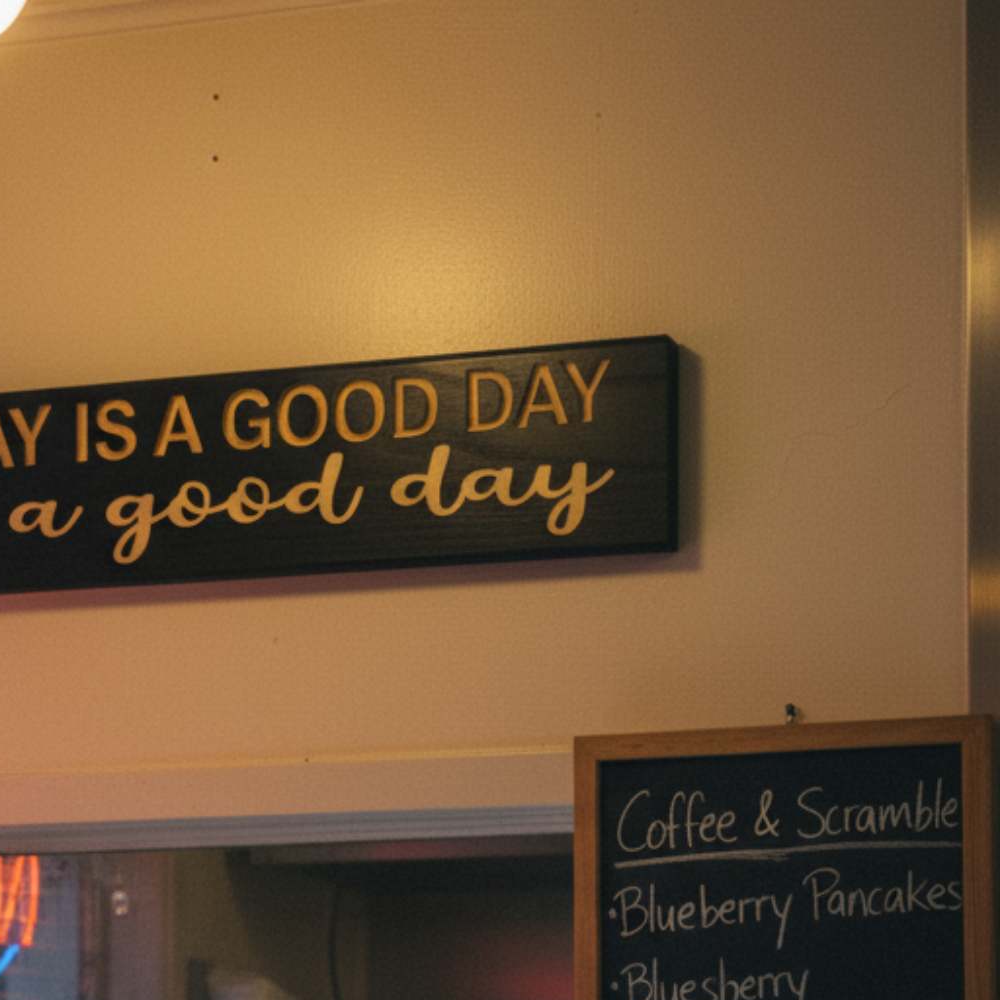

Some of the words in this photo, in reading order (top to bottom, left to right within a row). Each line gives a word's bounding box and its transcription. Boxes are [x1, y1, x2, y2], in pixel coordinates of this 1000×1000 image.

[75, 399, 137, 463] IS
[153, 395, 203, 457] A
[222, 378, 438, 450] GOOD
[467, 360, 610, 432] DAY
[8, 500, 83, 538] a
[105, 452, 363, 565] good
[390, 444, 614, 536] day
[617, 790, 738, 852] Coffee
[754, 790, 779, 838] &
[797, 778, 958, 839] Scramble
[803, 868, 962, 920] Pancakes
